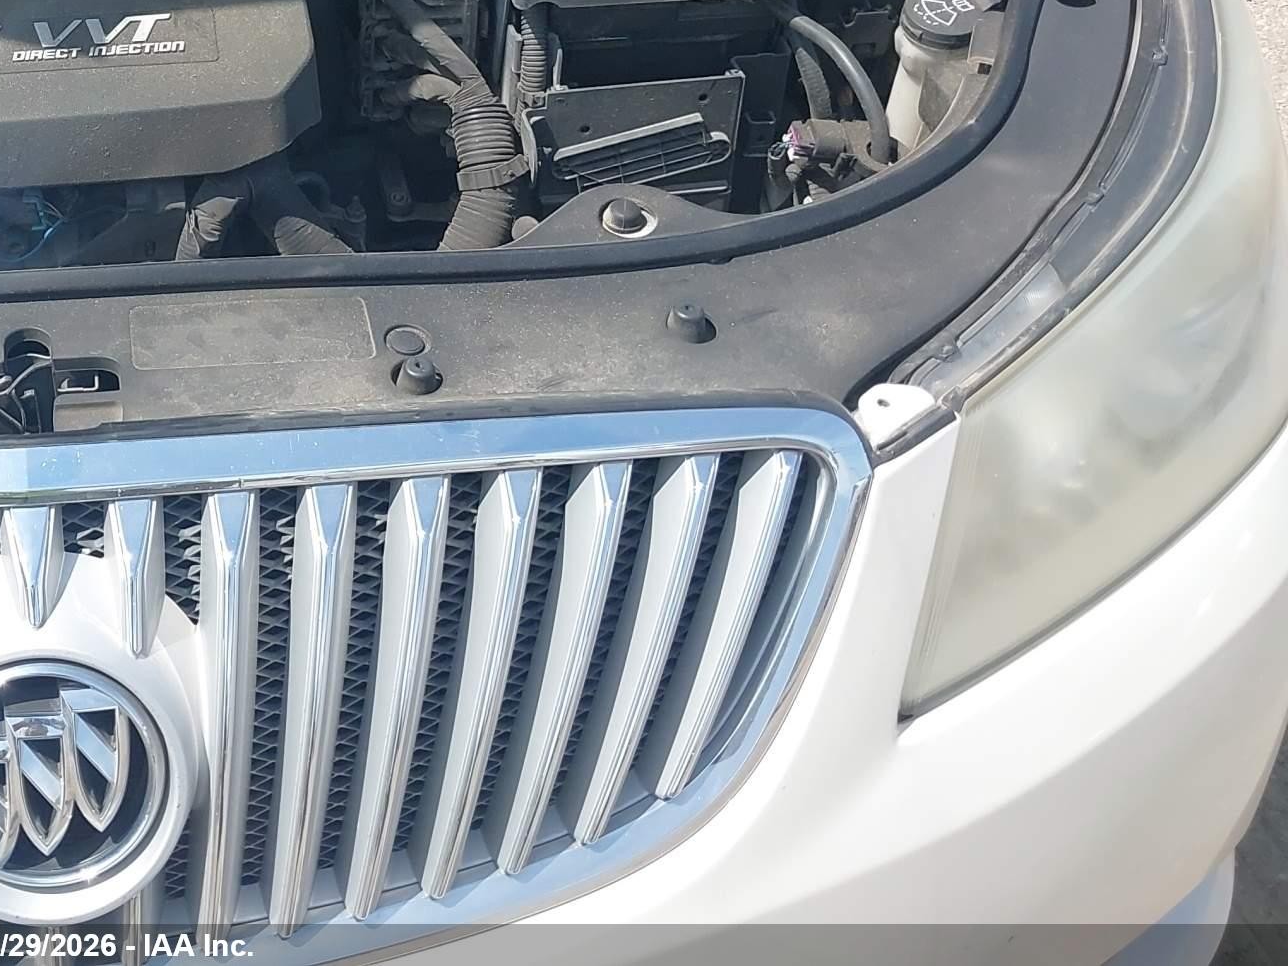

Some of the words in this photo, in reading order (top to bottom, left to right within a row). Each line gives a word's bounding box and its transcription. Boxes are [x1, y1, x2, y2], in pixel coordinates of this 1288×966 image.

[33, 13, 172, 48] VVT
[12, 47, 82, 62] DIRECT
[89, 39, 186, 58] INJECTION
